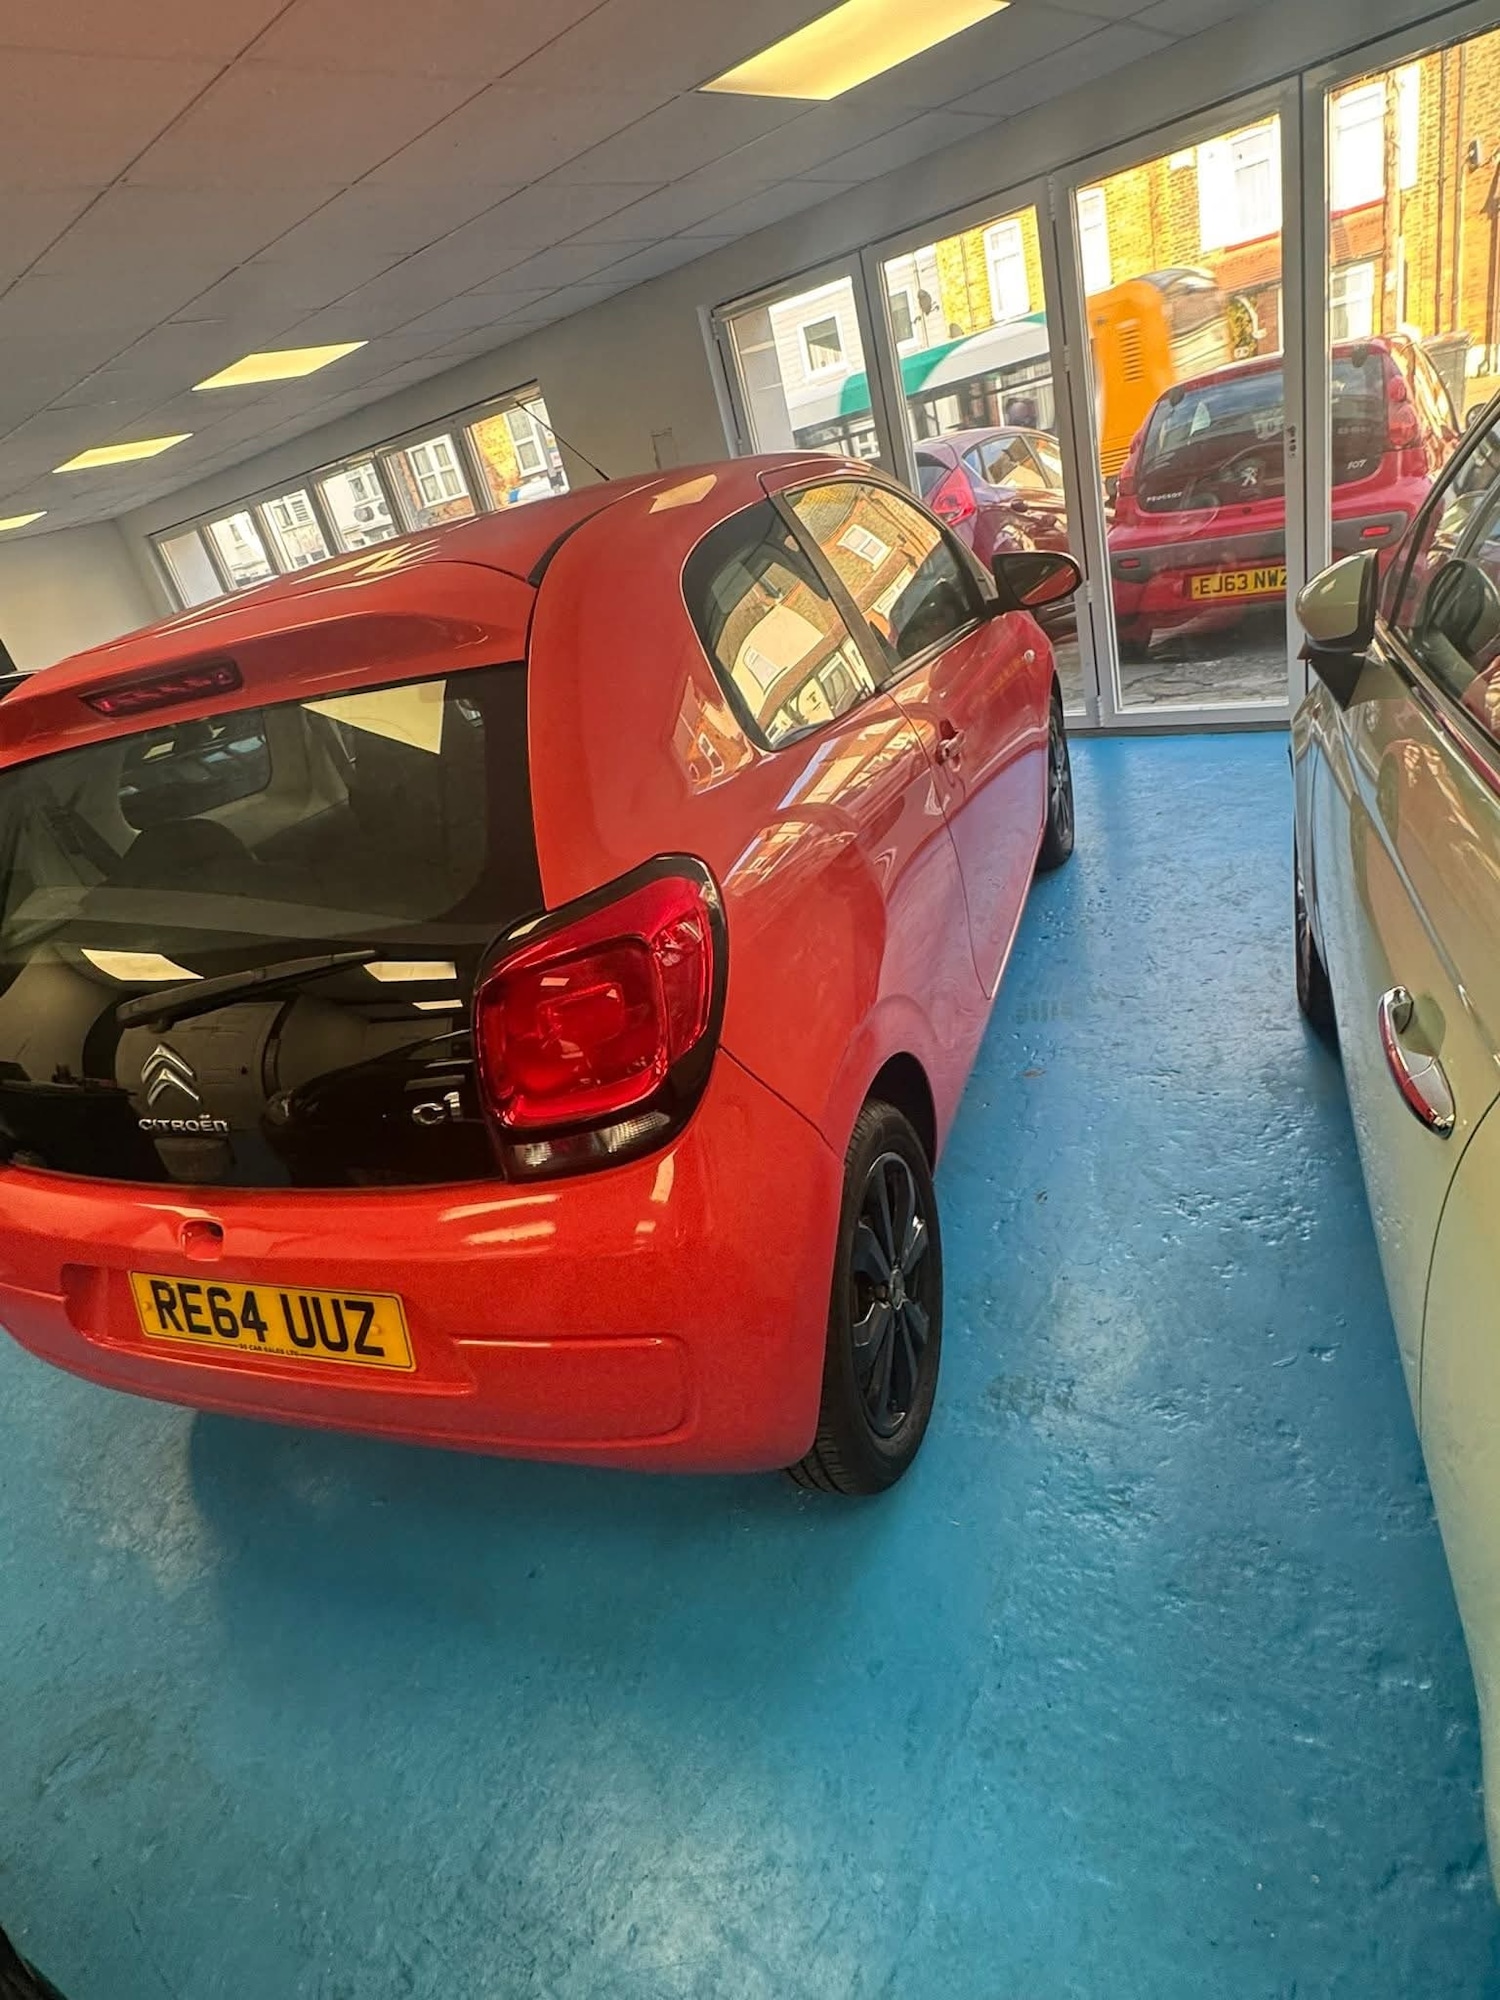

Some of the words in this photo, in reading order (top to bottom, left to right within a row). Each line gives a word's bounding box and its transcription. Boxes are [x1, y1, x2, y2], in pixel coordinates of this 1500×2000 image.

[1347, 459, 1367, 470] 107
[1200, 574, 1248, 595] EJ63
[150, 1280, 268, 1342] RE64
[280, 1294, 385, 1357] UUZ
